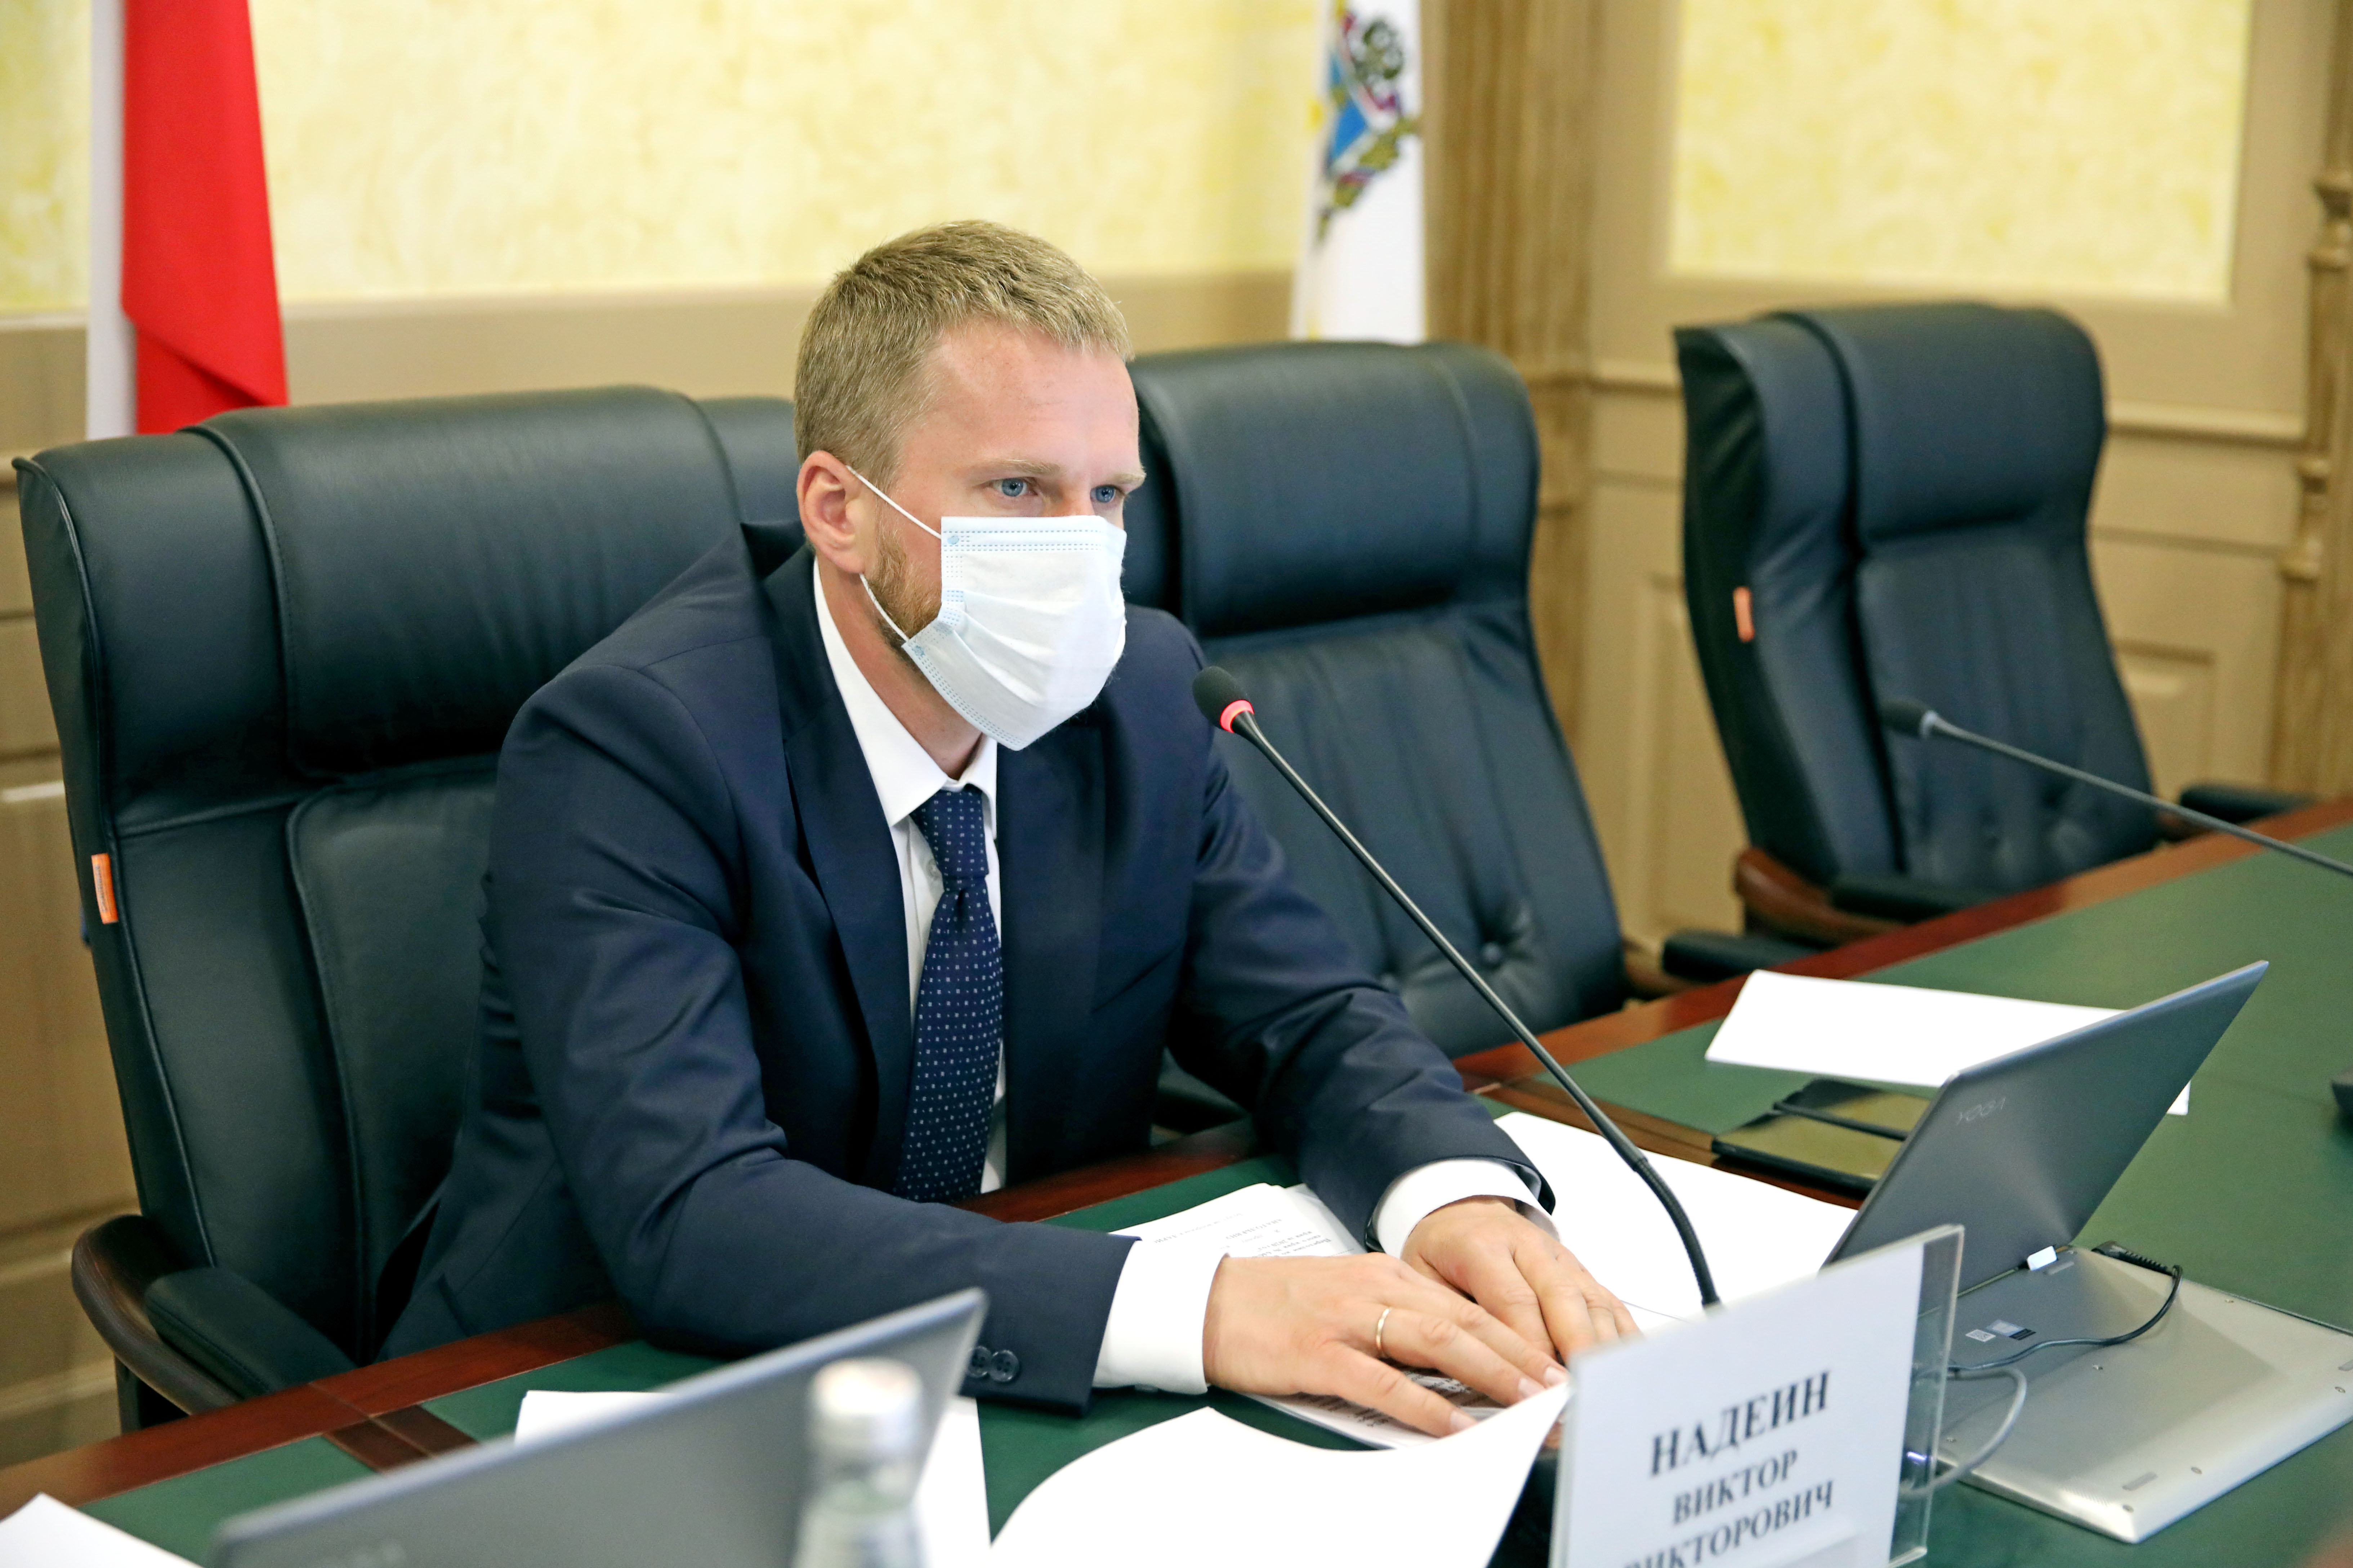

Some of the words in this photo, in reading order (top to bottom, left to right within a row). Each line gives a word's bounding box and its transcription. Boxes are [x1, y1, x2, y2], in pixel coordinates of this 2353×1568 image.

[1651, 1371, 1829, 1476] НАДЕИН
[1622, 1480, 1834, 1568] ИКТОРОВИЧ
[1672, 1448, 1798, 1527] ВИКТОР
